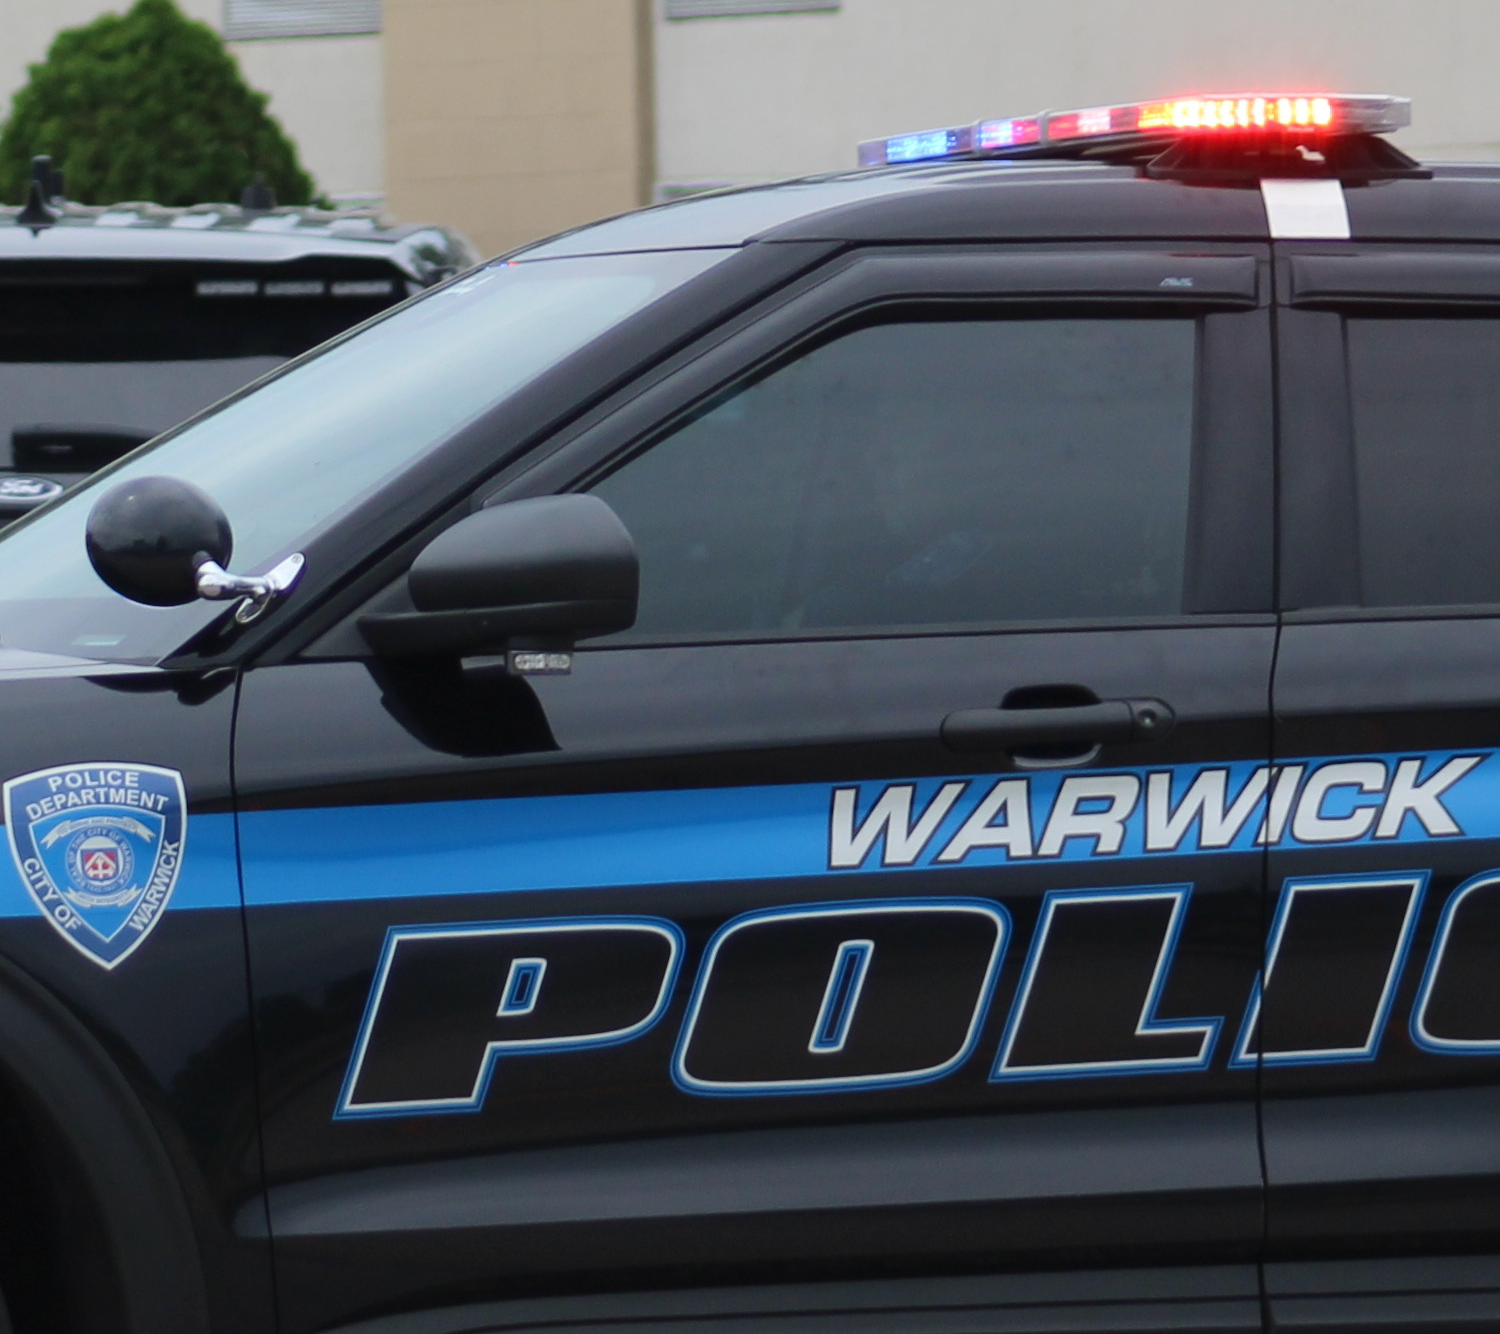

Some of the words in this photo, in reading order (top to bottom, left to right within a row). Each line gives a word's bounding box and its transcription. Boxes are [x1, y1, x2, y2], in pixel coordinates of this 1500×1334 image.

[25, 787, 170, 821] DEPARTMENT
[48, 770, 140, 792] POLICE
[827, 751, 1492, 870] WARWICK
[22, 857, 58, 903] CITY
[53, 903, 82, 932] OF
[128, 839, 181, 933] WARWICK
